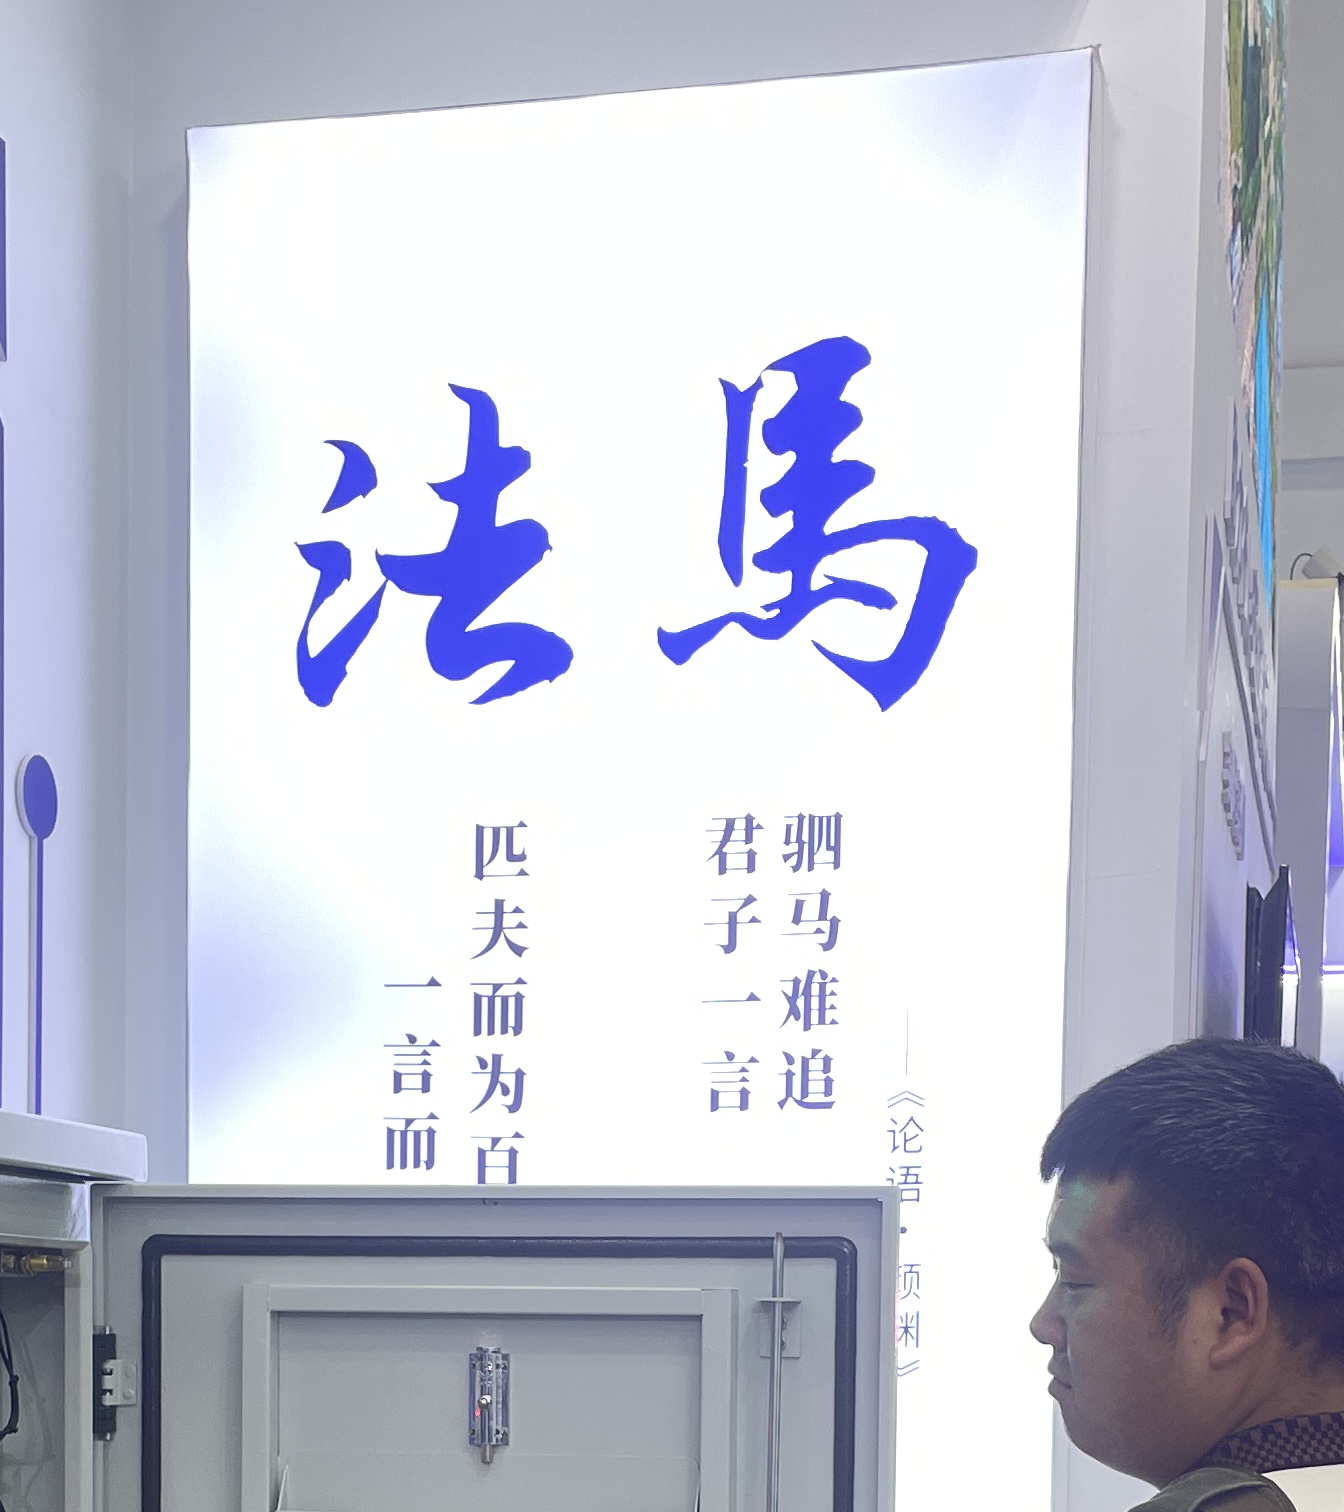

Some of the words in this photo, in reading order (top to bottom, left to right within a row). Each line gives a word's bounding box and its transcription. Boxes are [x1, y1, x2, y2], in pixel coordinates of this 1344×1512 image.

[383, 976, 442, 1171] 一言而
[702, 813, 764, 1112] 君子一言
[776, 811, 843, 1110] 驷马难追
